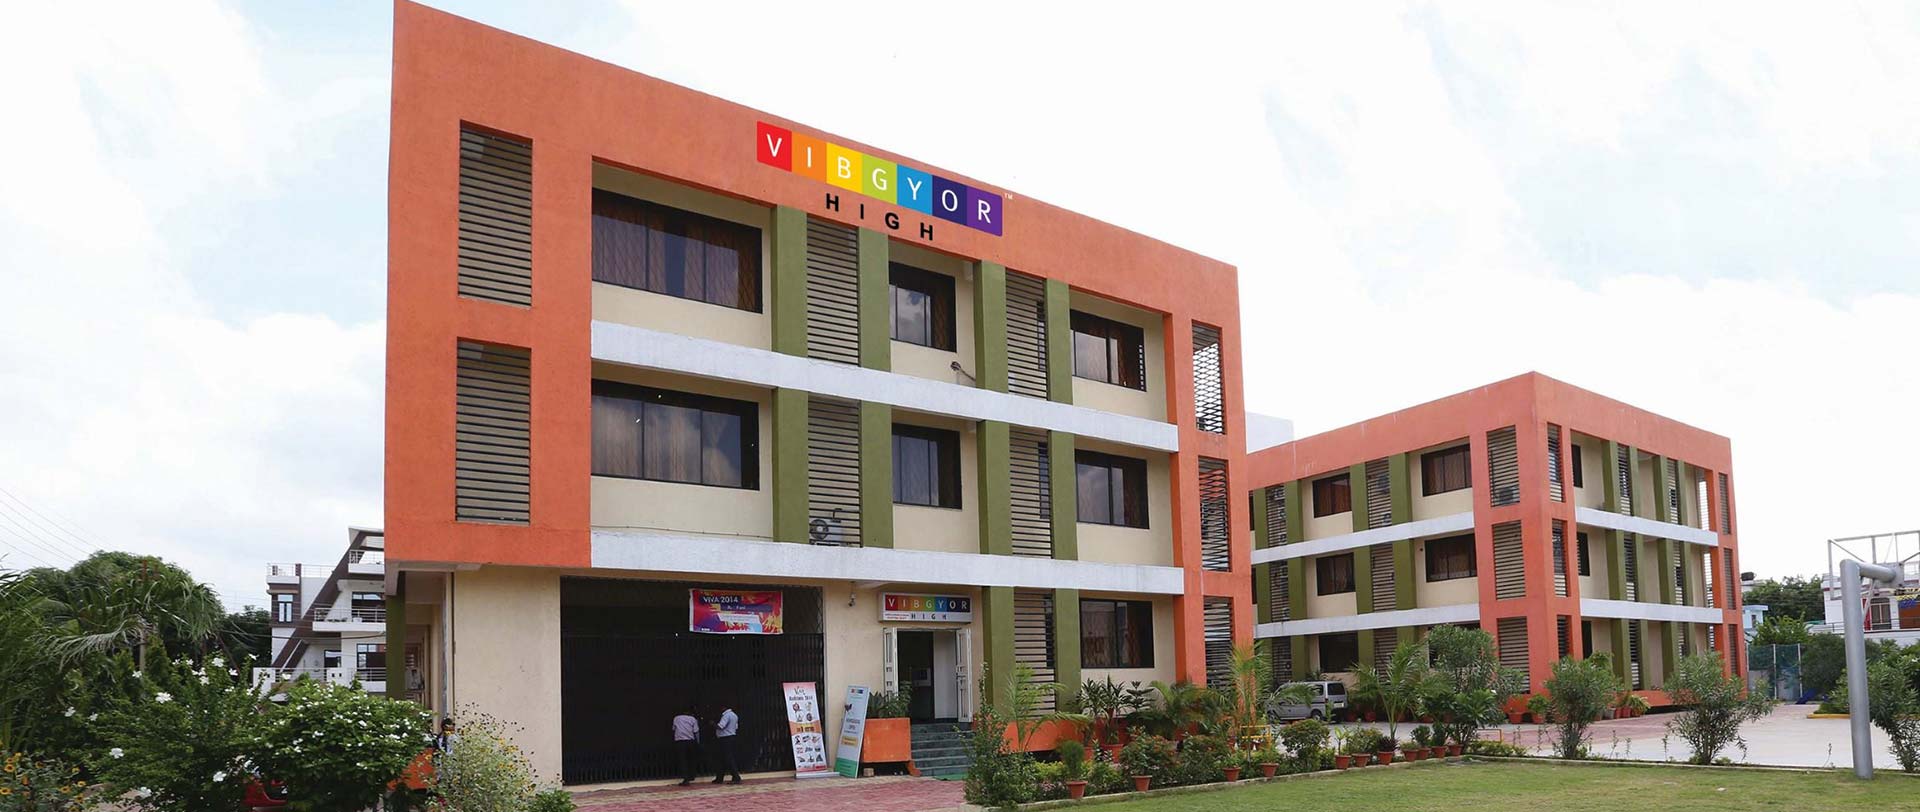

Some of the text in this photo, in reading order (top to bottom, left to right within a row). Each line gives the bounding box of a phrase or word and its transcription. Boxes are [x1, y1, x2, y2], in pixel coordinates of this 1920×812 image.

[766, 133, 992, 224] VIBGYOR
[826, 193, 934, 241] HIGH
[888, 598, 968, 610] VIBGYOR
